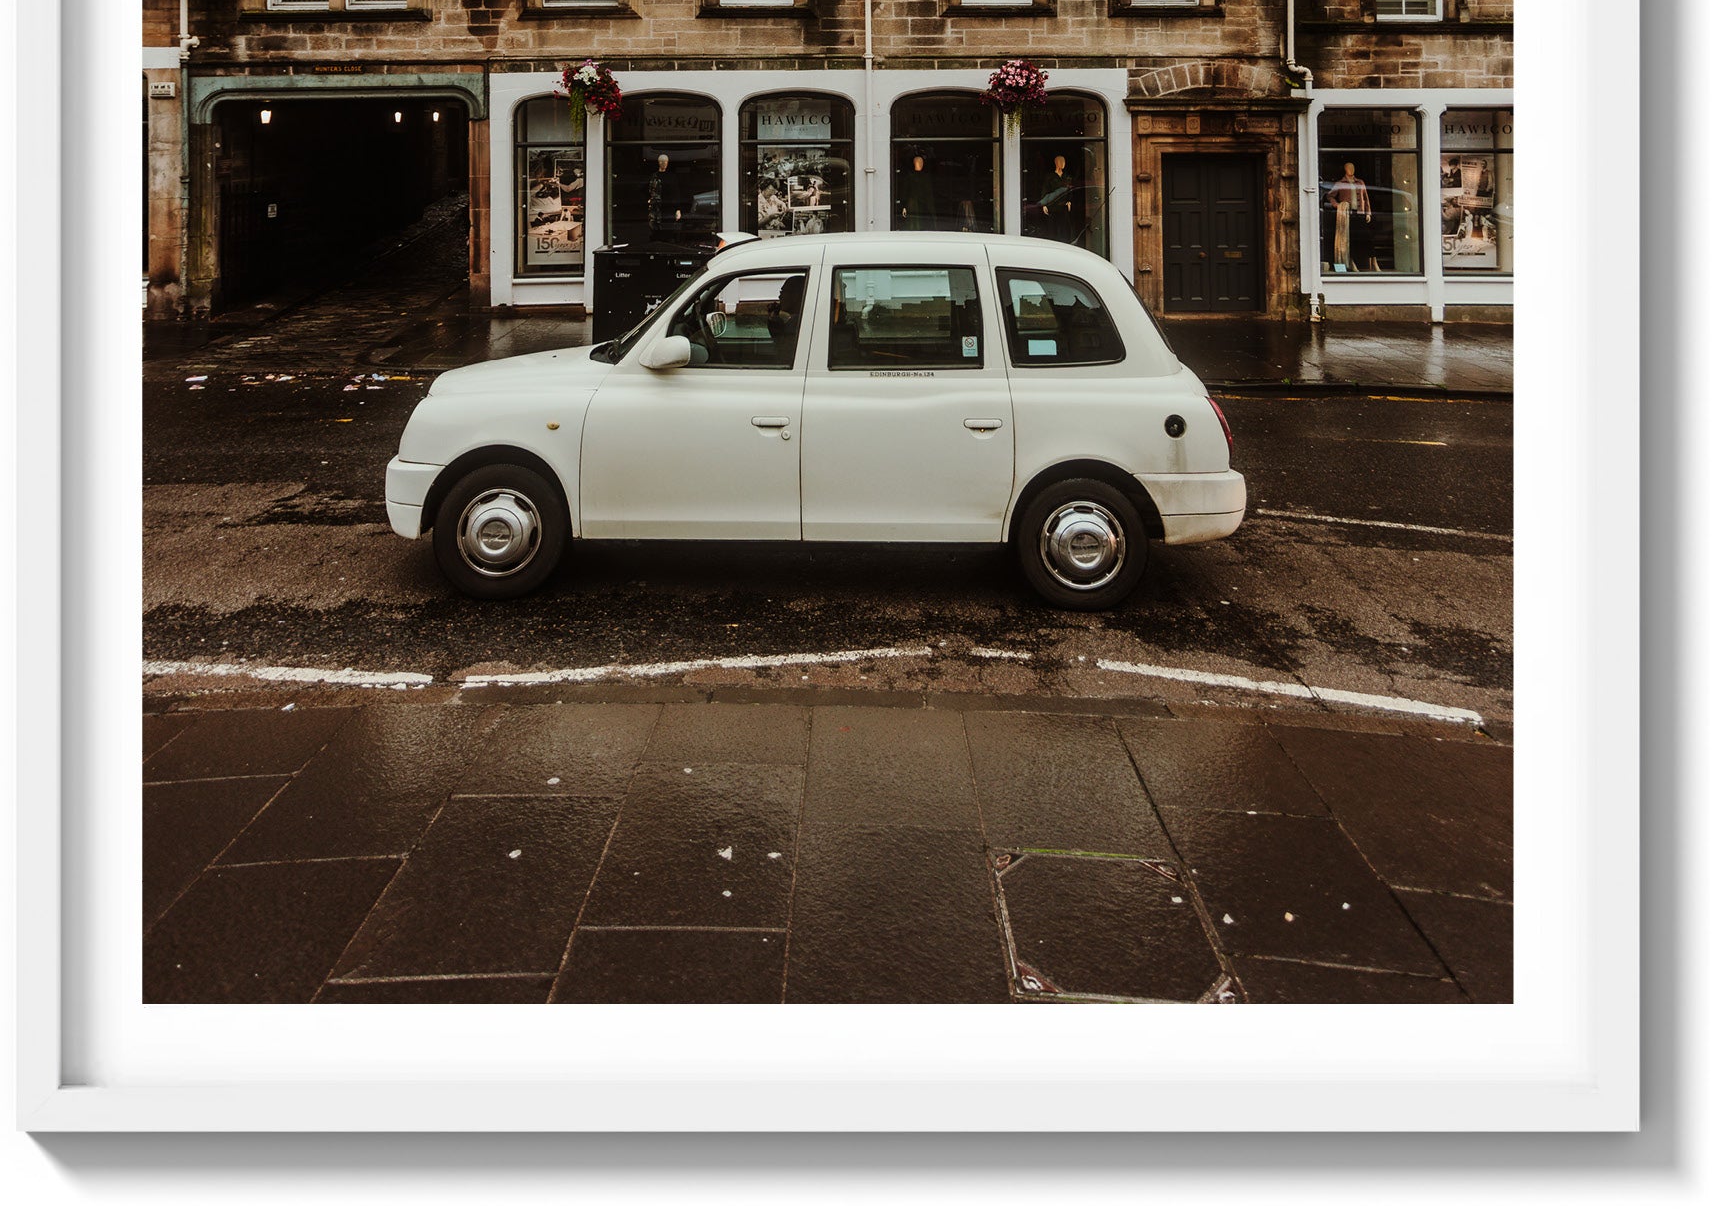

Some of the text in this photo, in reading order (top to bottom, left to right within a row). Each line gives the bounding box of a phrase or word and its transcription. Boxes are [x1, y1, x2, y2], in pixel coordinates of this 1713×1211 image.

[343, 65, 362, 73] CLOSE
[761, 115, 832, 126] HAWICO
[912, 112, 981, 124] HAWICO
[1333, 124, 1401, 135] HAWICO
[1444, 124, 1513, 135] HAWICO
